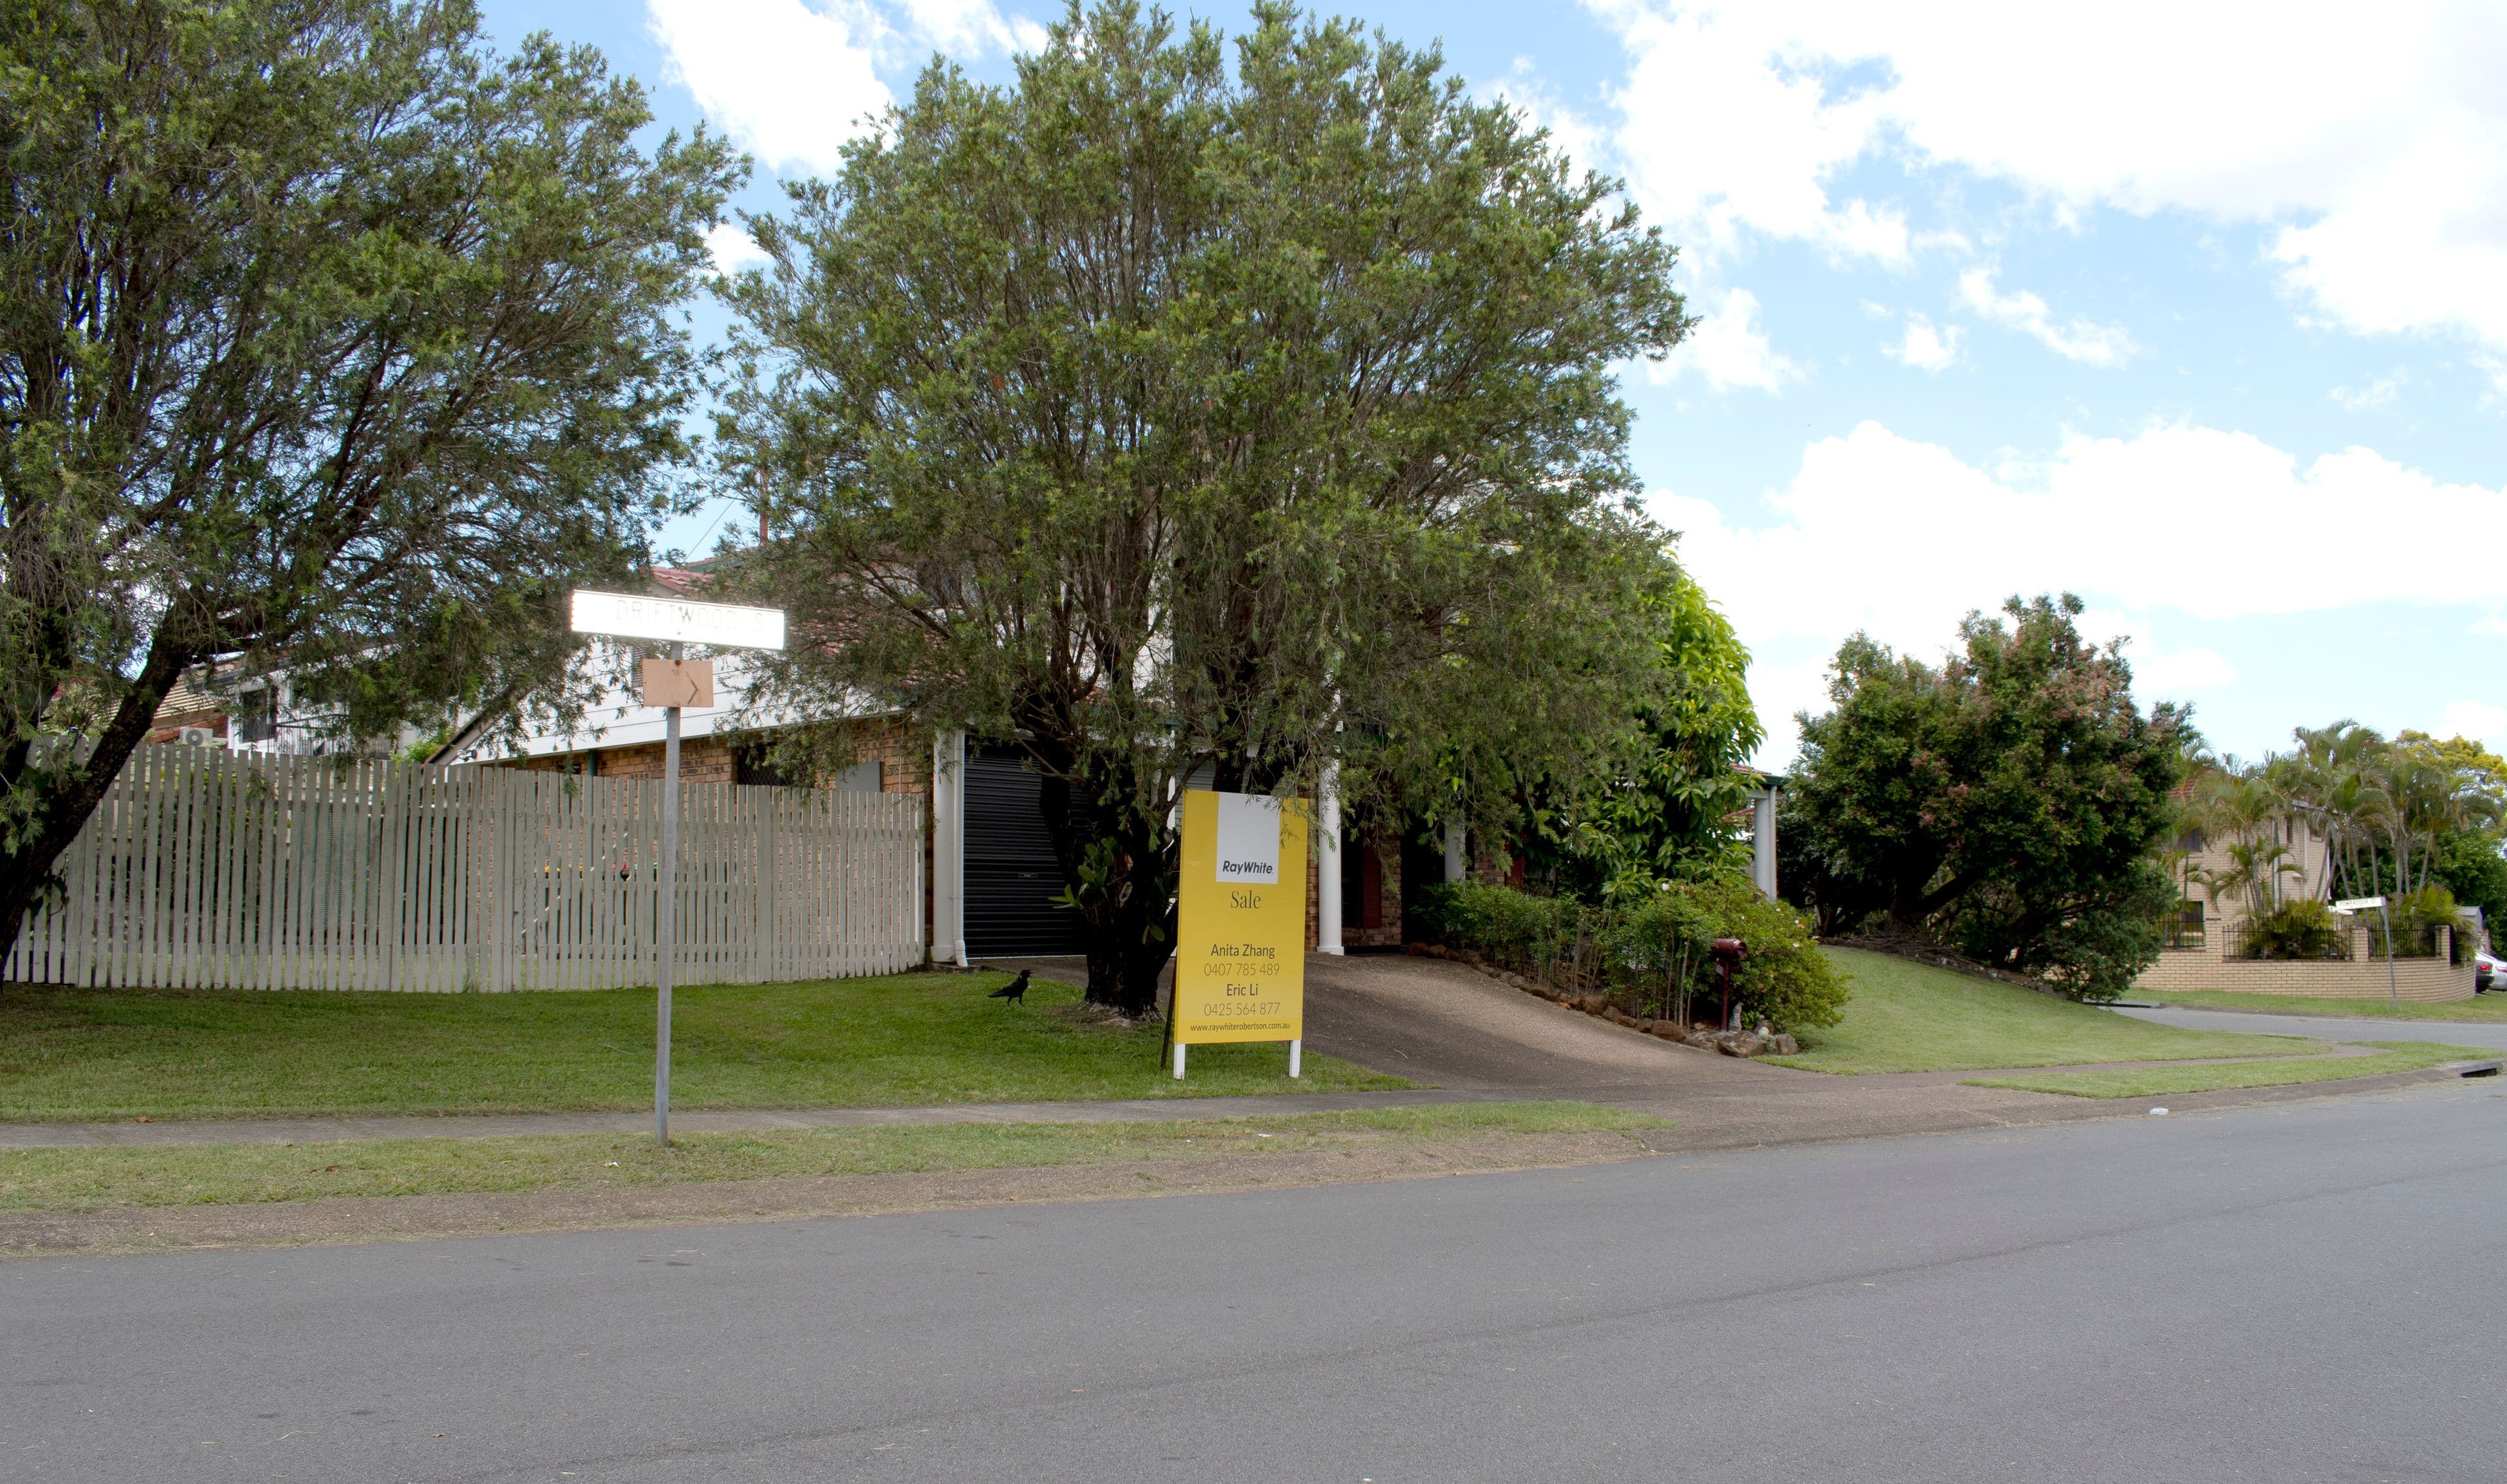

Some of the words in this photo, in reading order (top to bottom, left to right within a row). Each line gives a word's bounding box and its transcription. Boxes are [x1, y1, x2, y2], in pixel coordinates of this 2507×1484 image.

[616, 599, 738, 631] DRIFTWOOD
[1231, 890, 1261, 909] Sale
[1210, 943, 1239, 956] Anita
[1242, 943, 1275, 959] Zhang
[1204, 963, 1233, 976] 0407
[1236, 963, 1256, 976] 785
[1259, 963, 1280, 976] 489
[1226, 983, 1246, 996] Eric
[1250, 983, 1258, 996] Li
[1204, 1003, 1232, 1017] 0425
[1236, 1003, 1256, 1016] 564
[1259, 1002, 1280, 1015] 877
[1190, 1022, 1290, 1032] www.raywhiterobertson.com.au
